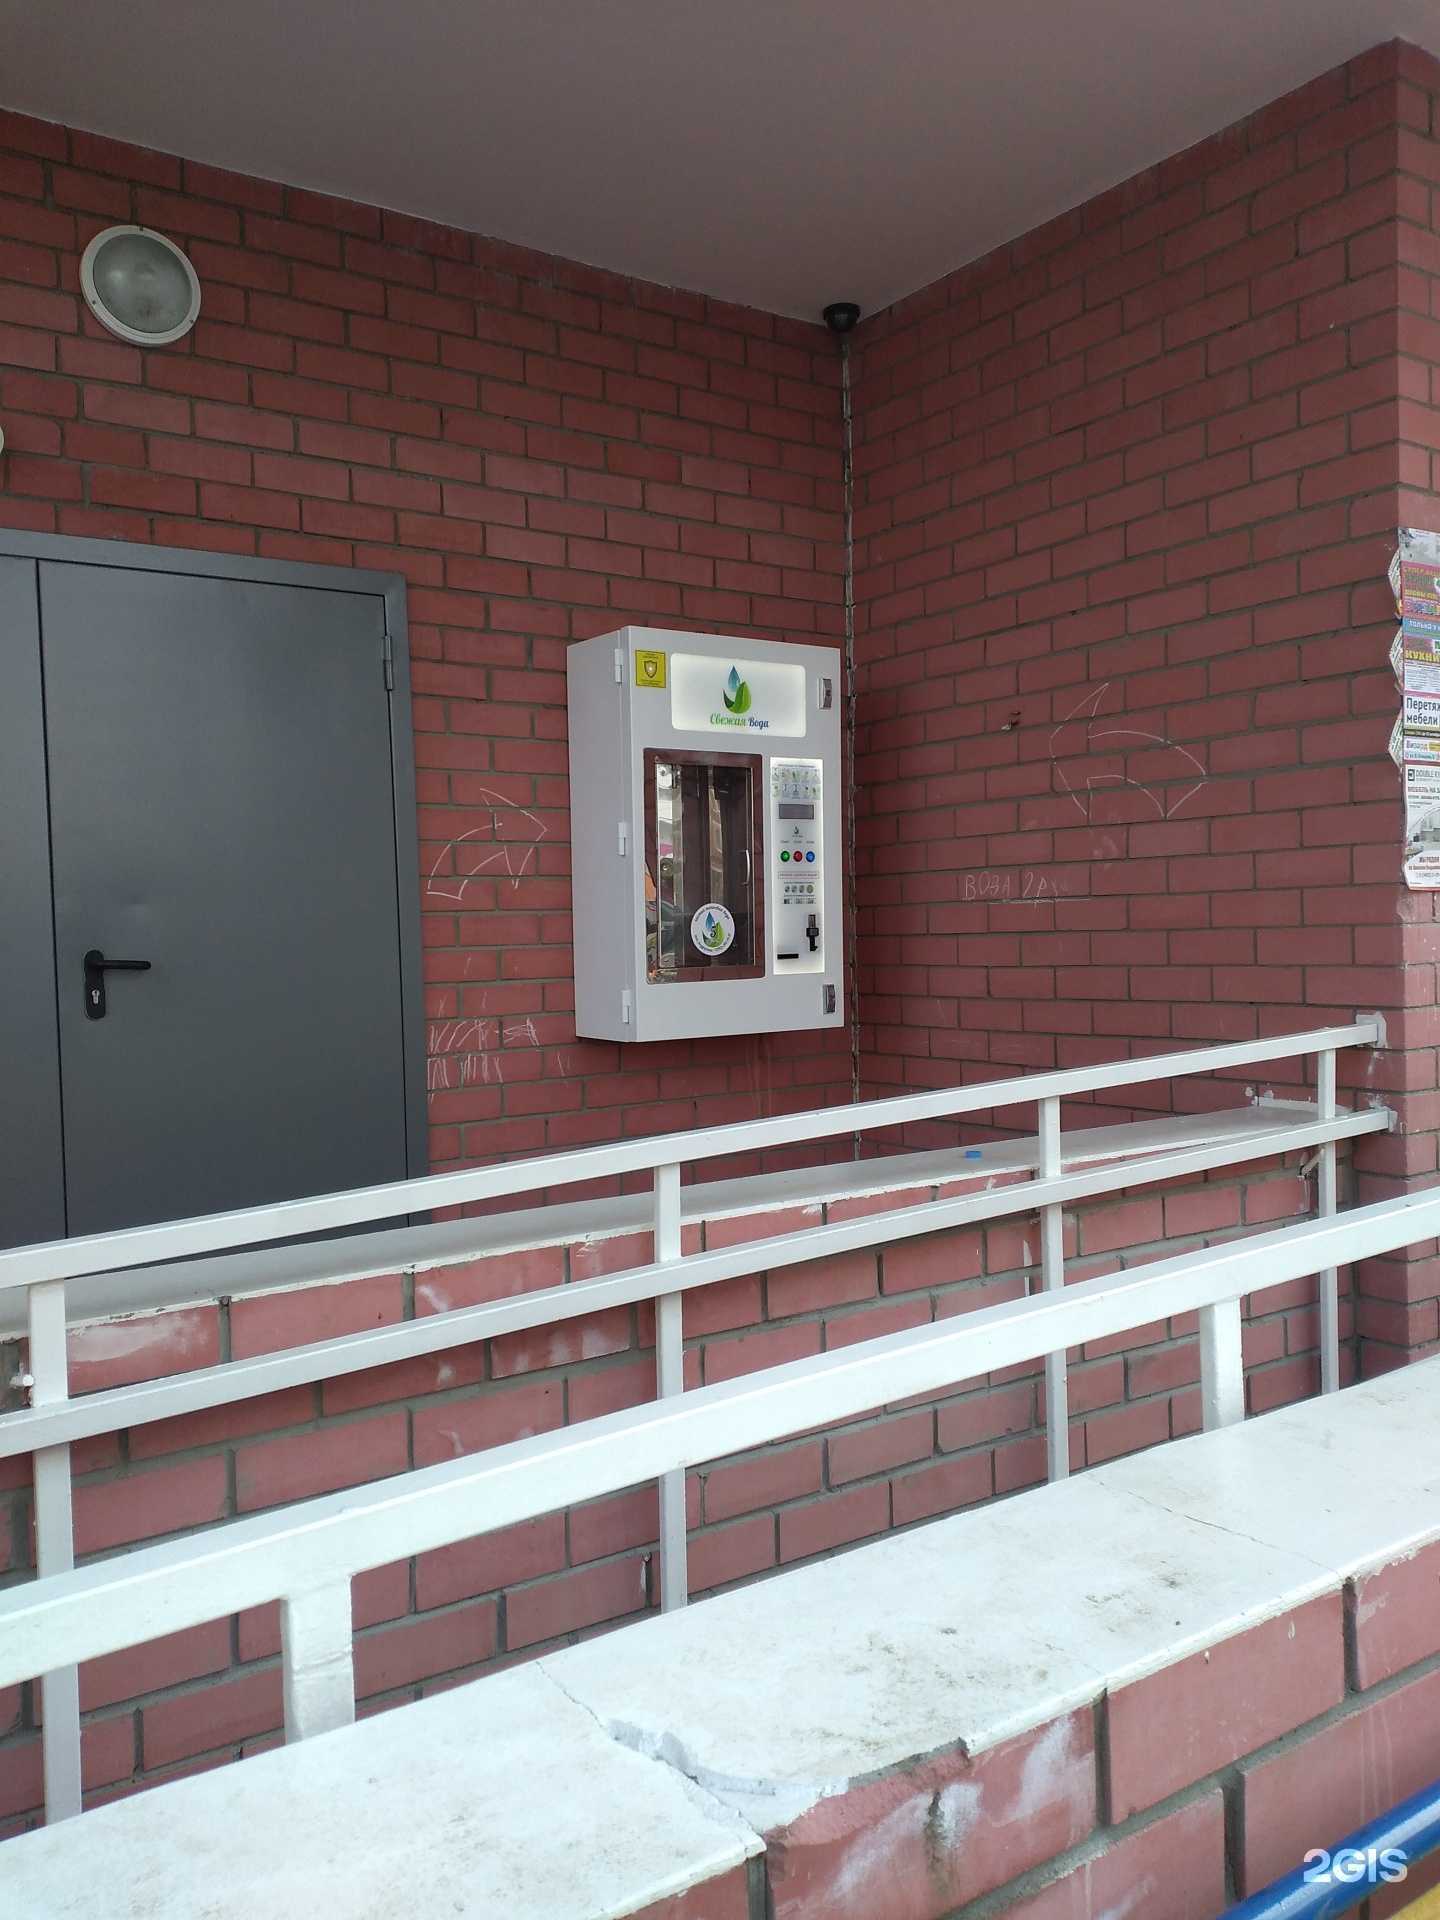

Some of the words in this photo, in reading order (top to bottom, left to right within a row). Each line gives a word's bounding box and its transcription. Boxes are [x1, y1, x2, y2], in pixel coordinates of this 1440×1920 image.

[710, 712, 746, 727] Свежая
[747, 716, 769, 730] Вода
[1406, 713, 1438, 726] мебели
